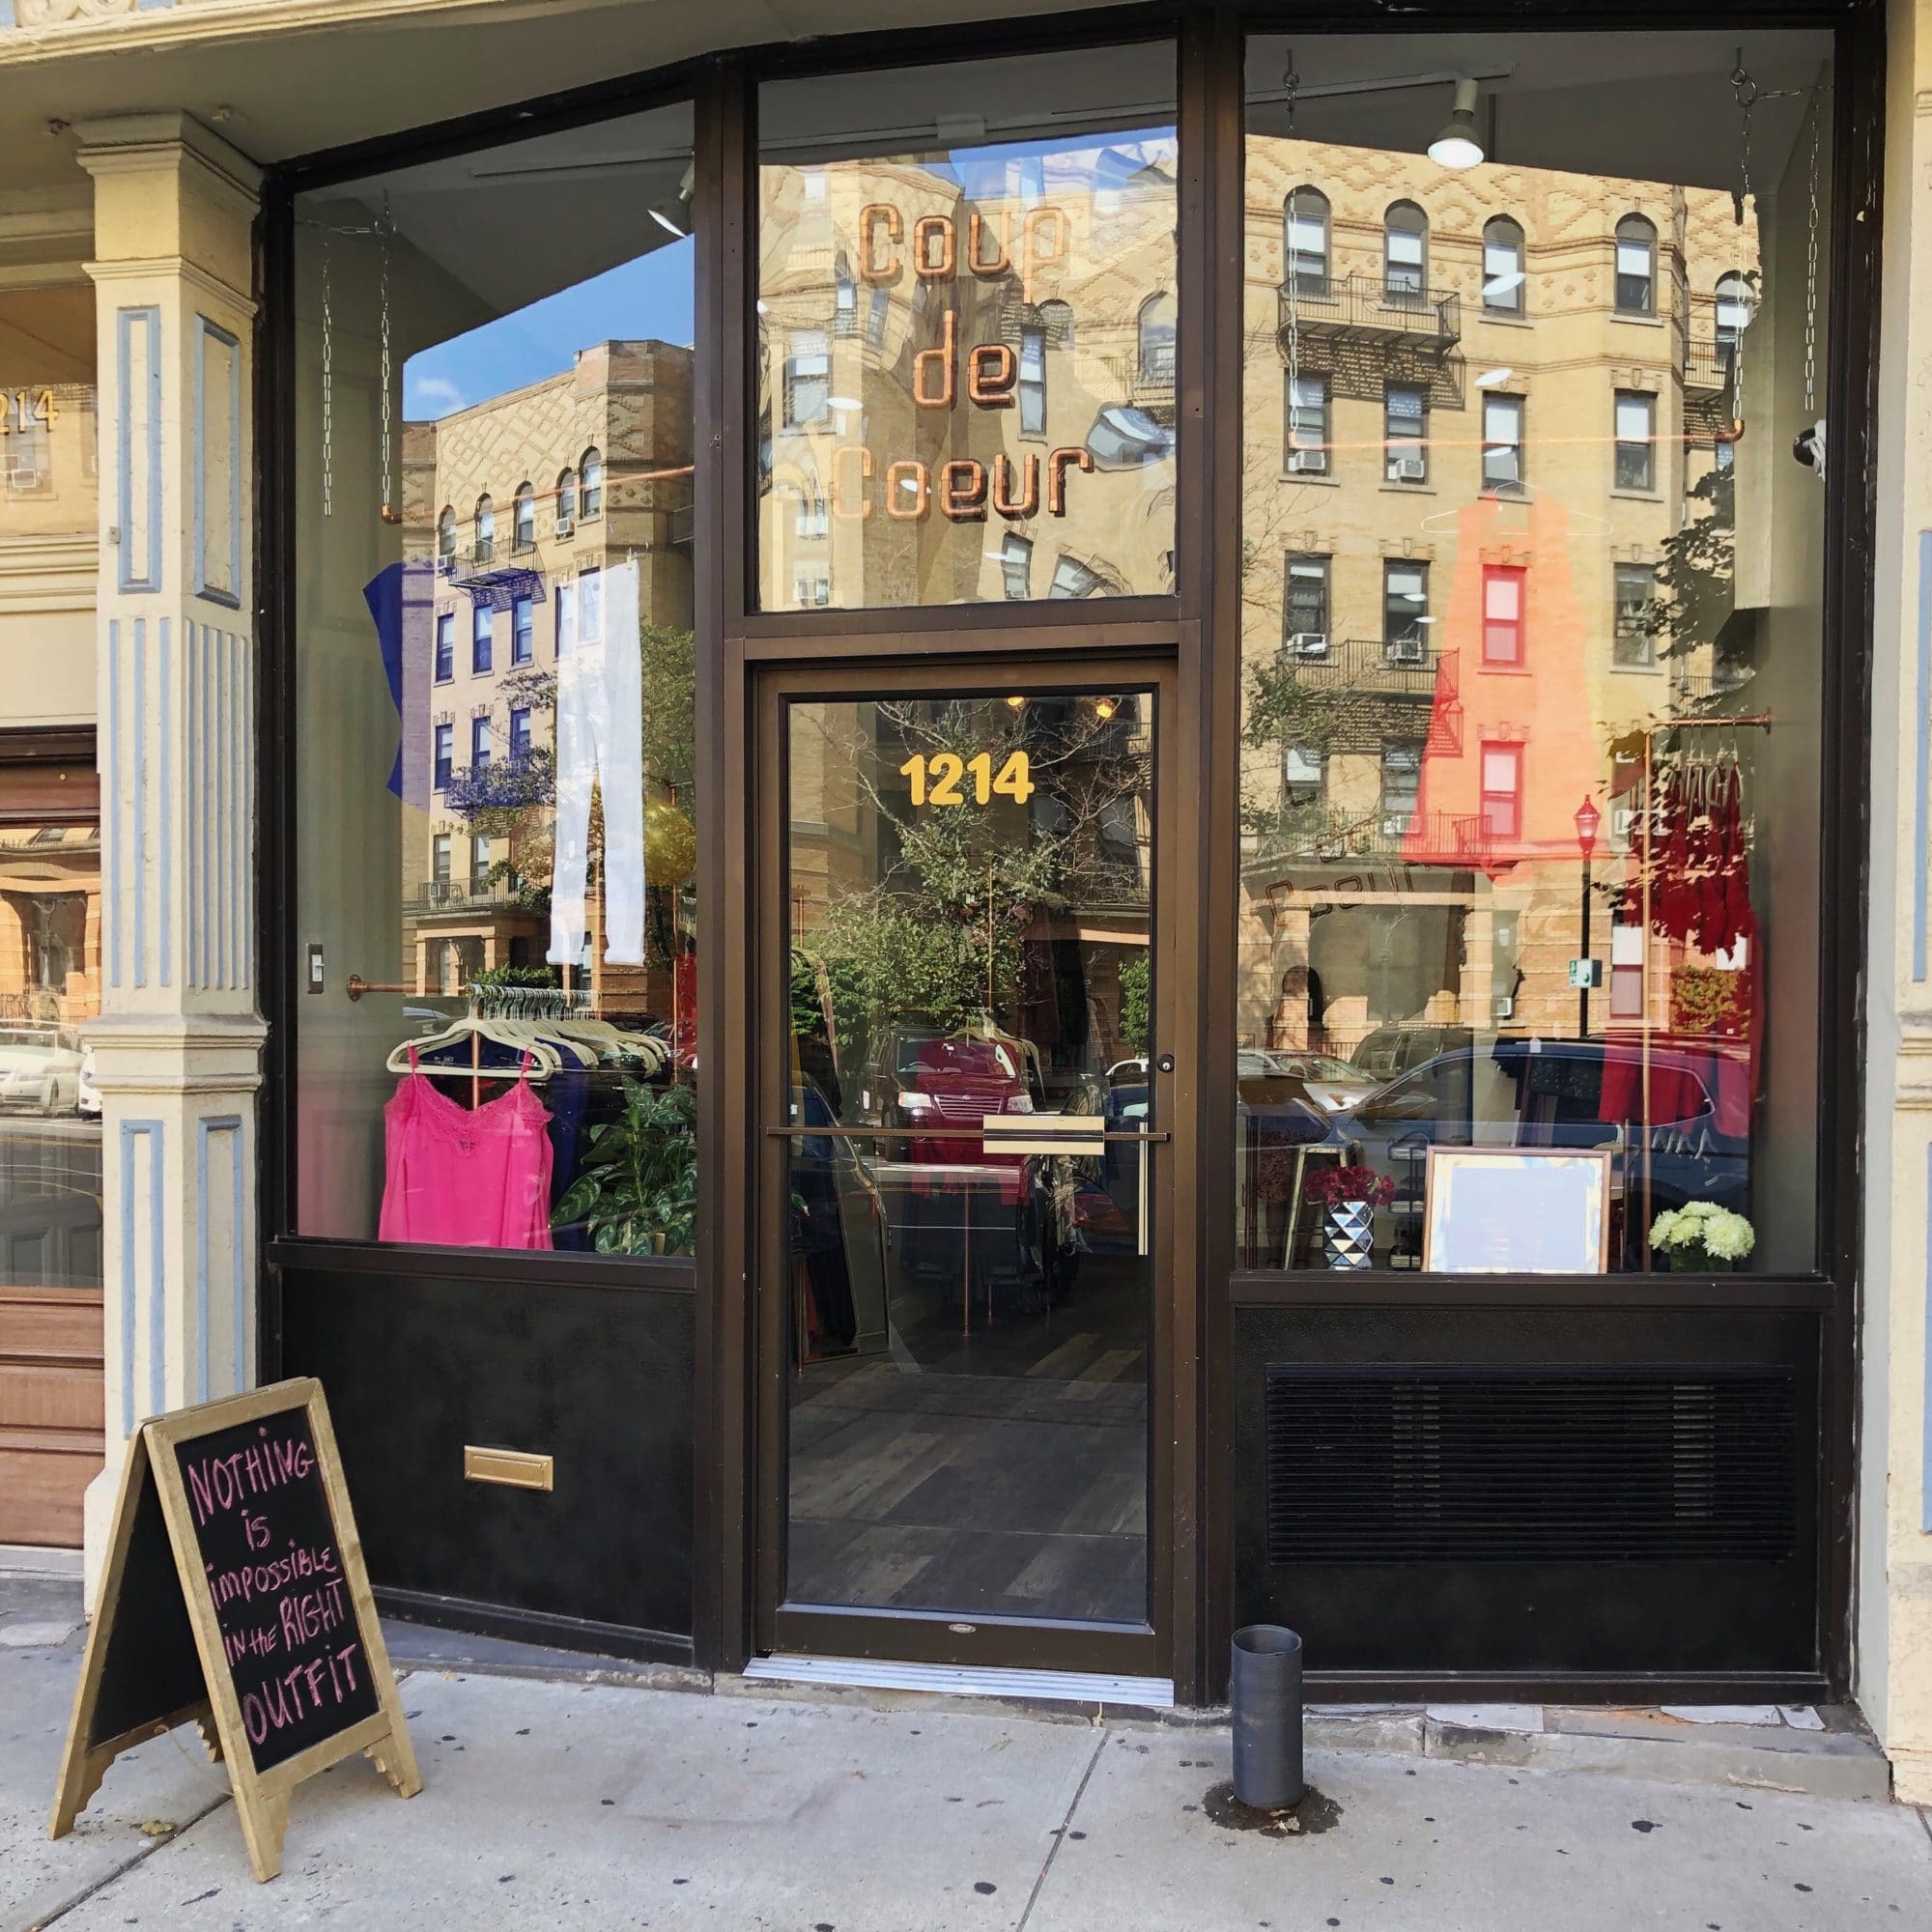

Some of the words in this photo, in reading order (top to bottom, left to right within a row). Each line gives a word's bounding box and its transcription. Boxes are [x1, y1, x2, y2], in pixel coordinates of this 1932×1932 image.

[858, 202, 1066, 304] Coup
[912, 309, 1015, 409] de
[832, 445, 1094, 523] Coeur
[900, 752, 1035, 807] 1214
[279, 1577, 344, 1652] RIGHT
